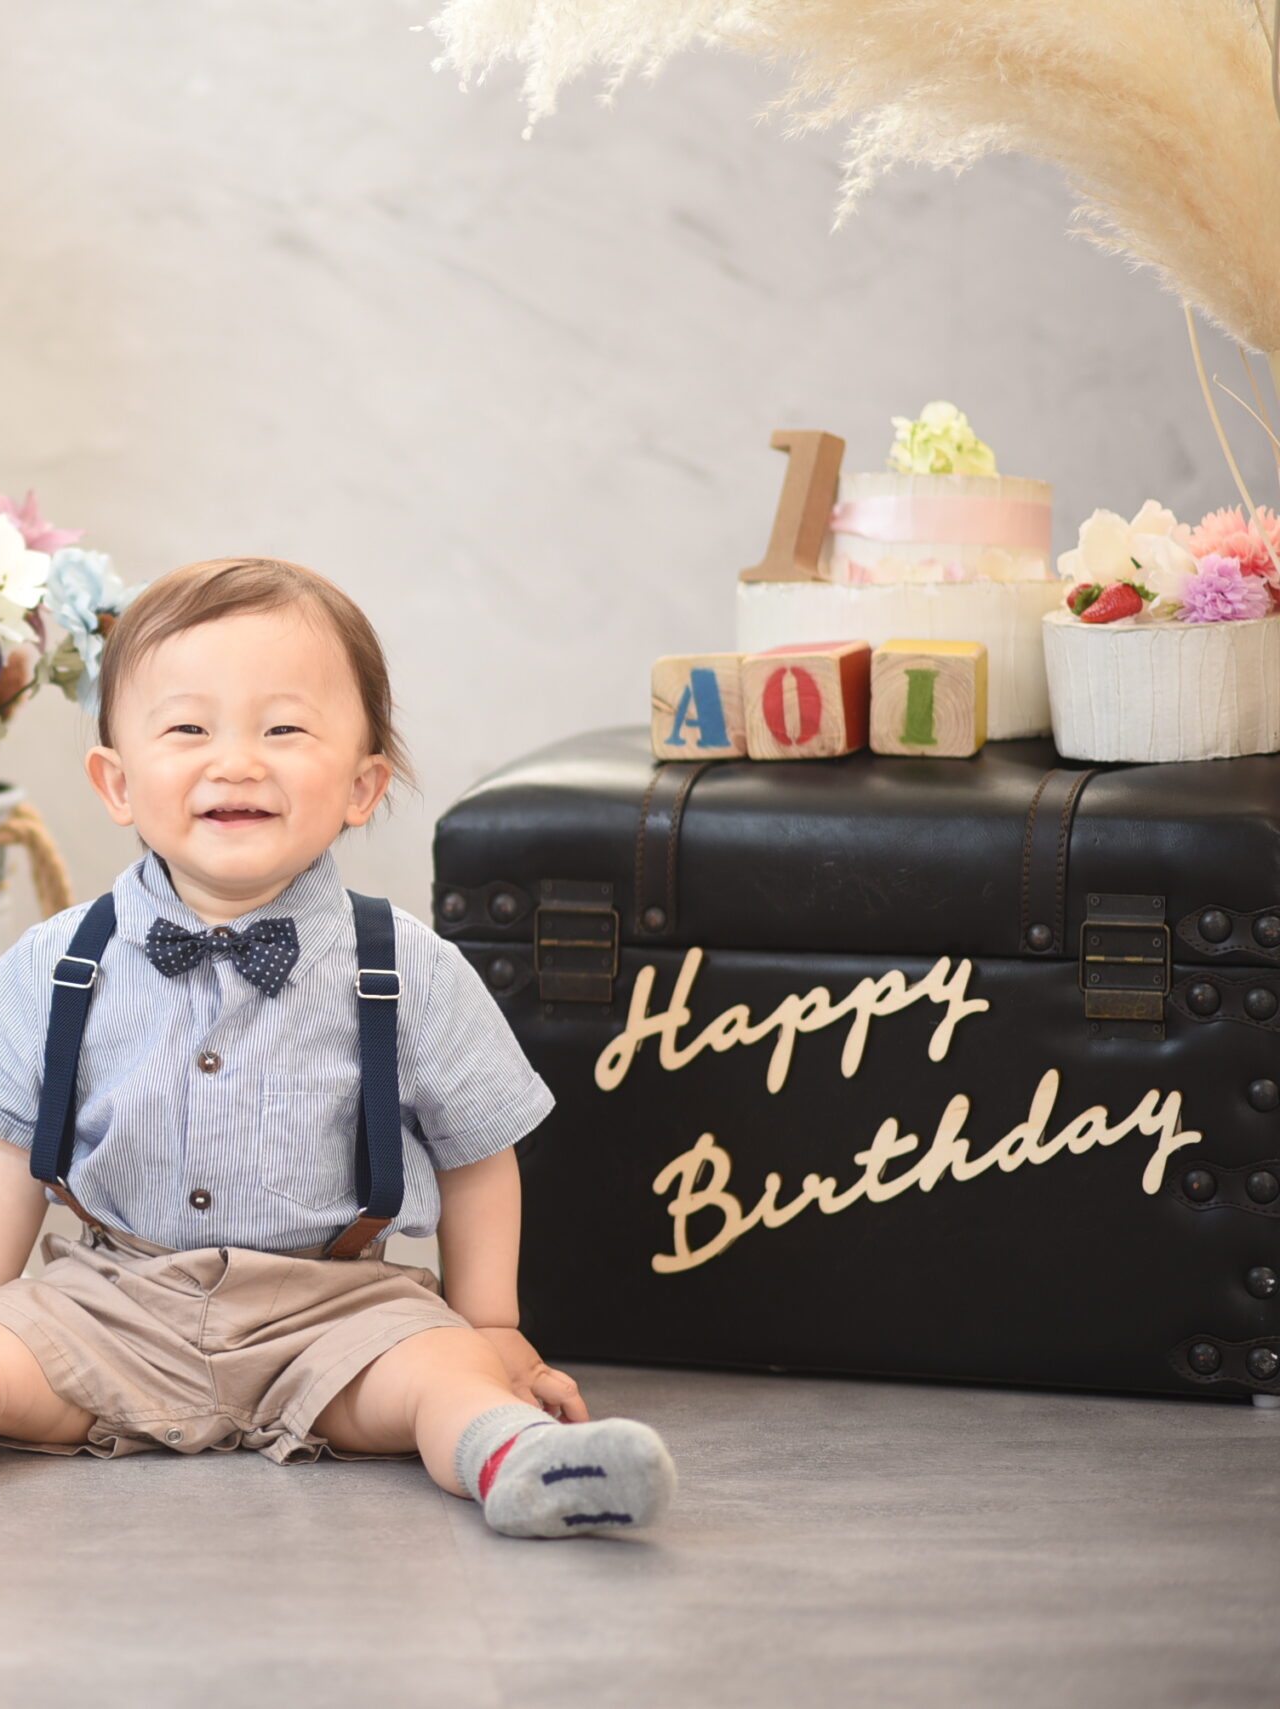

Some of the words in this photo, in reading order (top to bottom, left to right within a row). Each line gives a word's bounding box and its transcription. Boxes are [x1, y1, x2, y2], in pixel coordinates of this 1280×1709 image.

[739, 430, 845, 582] 1
[594, 946, 989, 1094] Happy
[651, 1068, 1202, 1273] Birthday
